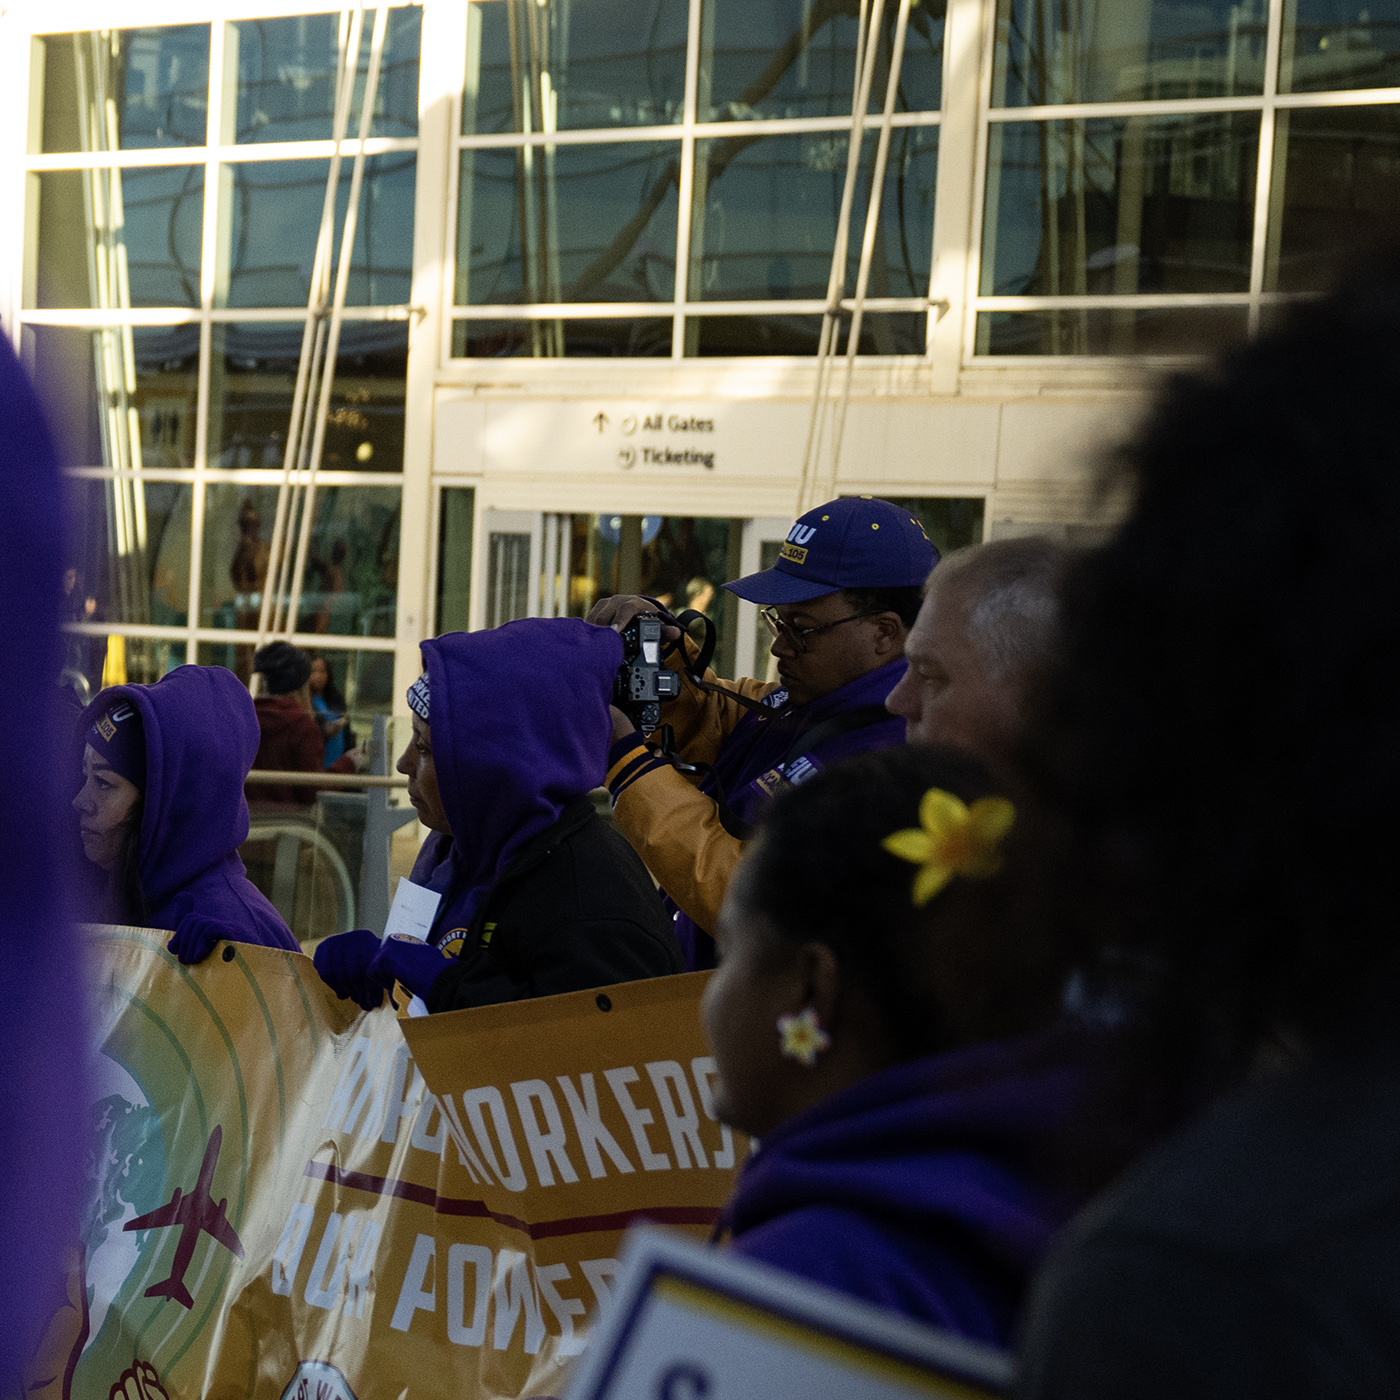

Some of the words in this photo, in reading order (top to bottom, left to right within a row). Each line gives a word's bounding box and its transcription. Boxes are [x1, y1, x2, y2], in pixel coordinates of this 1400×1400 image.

[642, 413, 663, 431] All
[667, 414, 714, 432] Gates
[642, 446, 715, 470] Ticketing
[270, 1201, 382, 1319] OUR
